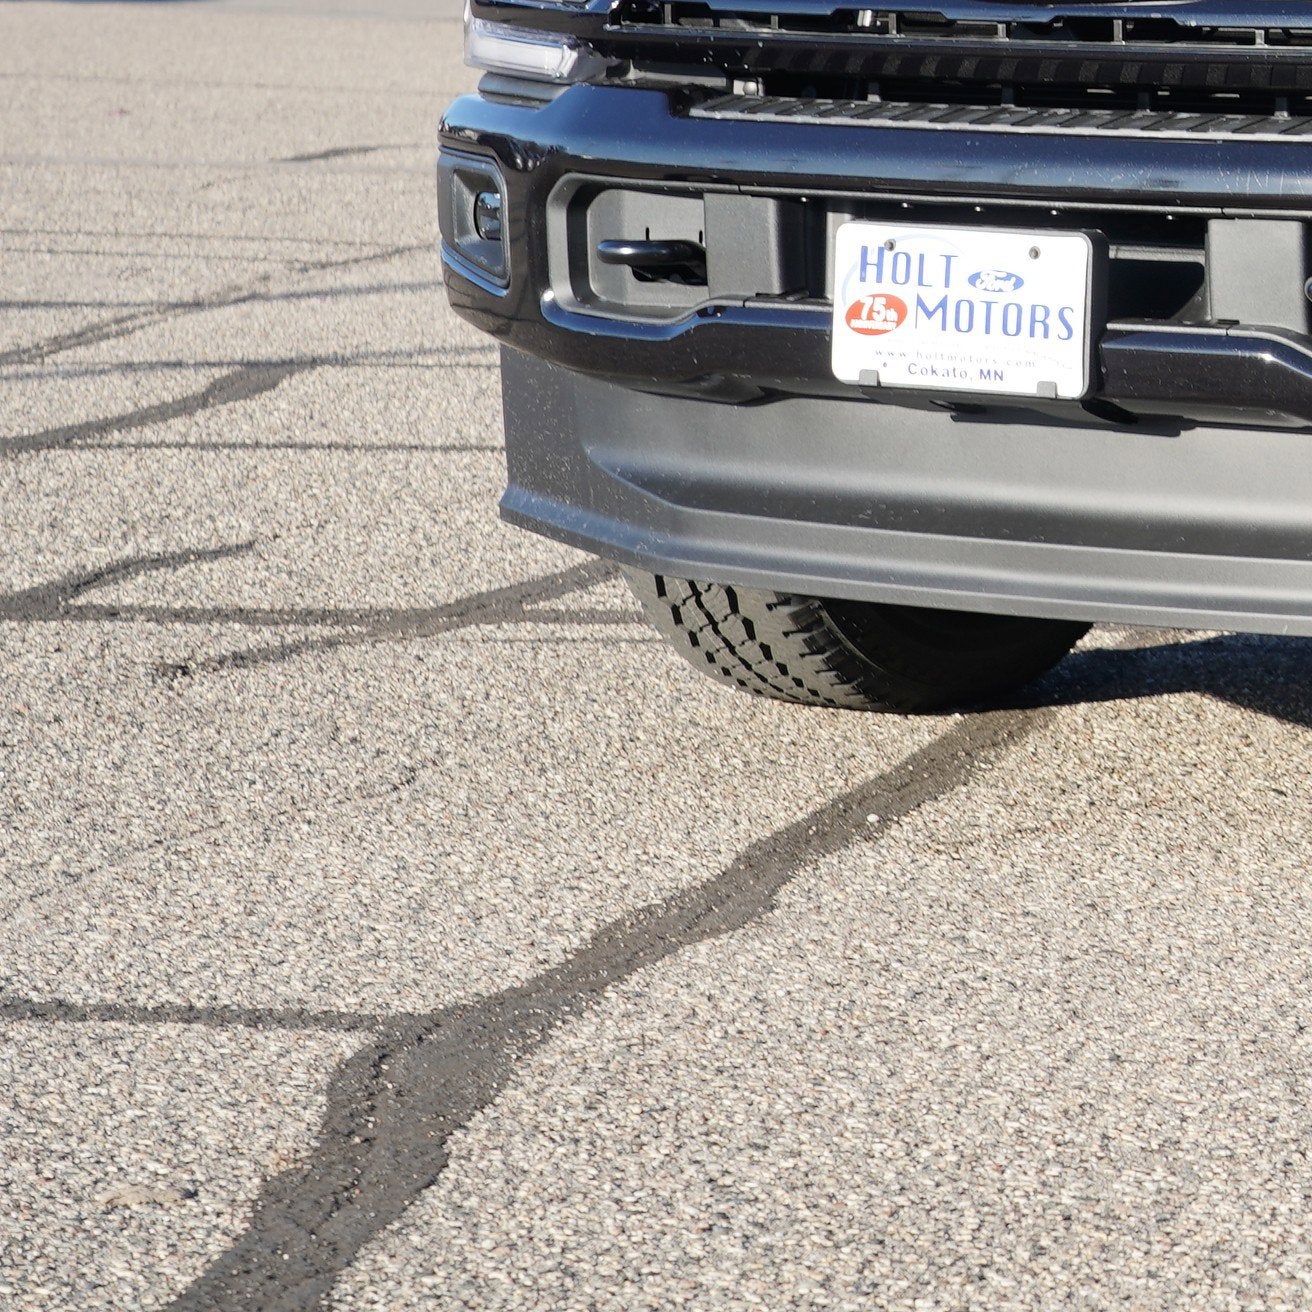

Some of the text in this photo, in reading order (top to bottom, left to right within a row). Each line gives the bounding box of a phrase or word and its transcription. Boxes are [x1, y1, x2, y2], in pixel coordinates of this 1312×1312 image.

[859, 245, 959, 288] HOLT
[914, 292, 1074, 341] MOTORS
[908, 362, 1004, 382] Cokato, MN
